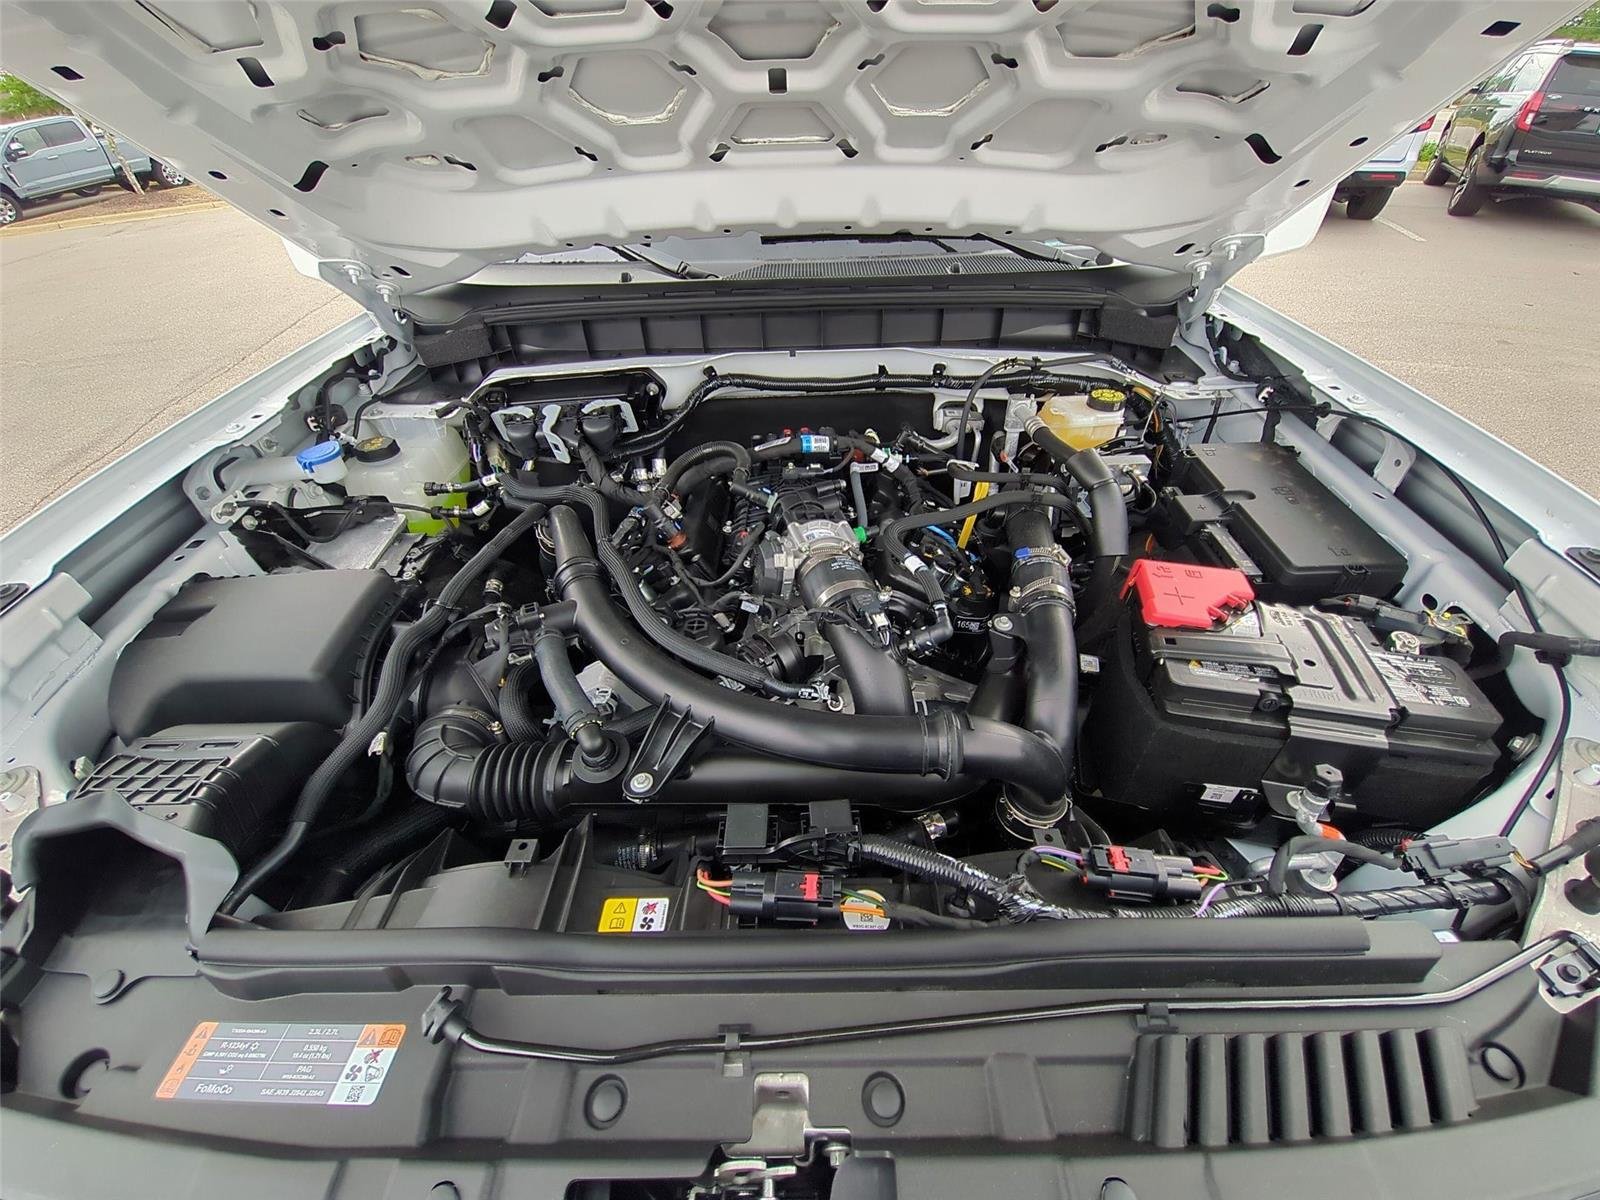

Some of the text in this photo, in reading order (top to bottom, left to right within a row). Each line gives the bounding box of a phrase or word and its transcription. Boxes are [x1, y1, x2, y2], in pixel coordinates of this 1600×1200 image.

[220, 1041, 249, 1051] R-1234yf
[296, 1065, 313, 1073] PAG
[195, 1083, 233, 1095] FoMoCo
[260, 1088, 274, 1096] SAE
